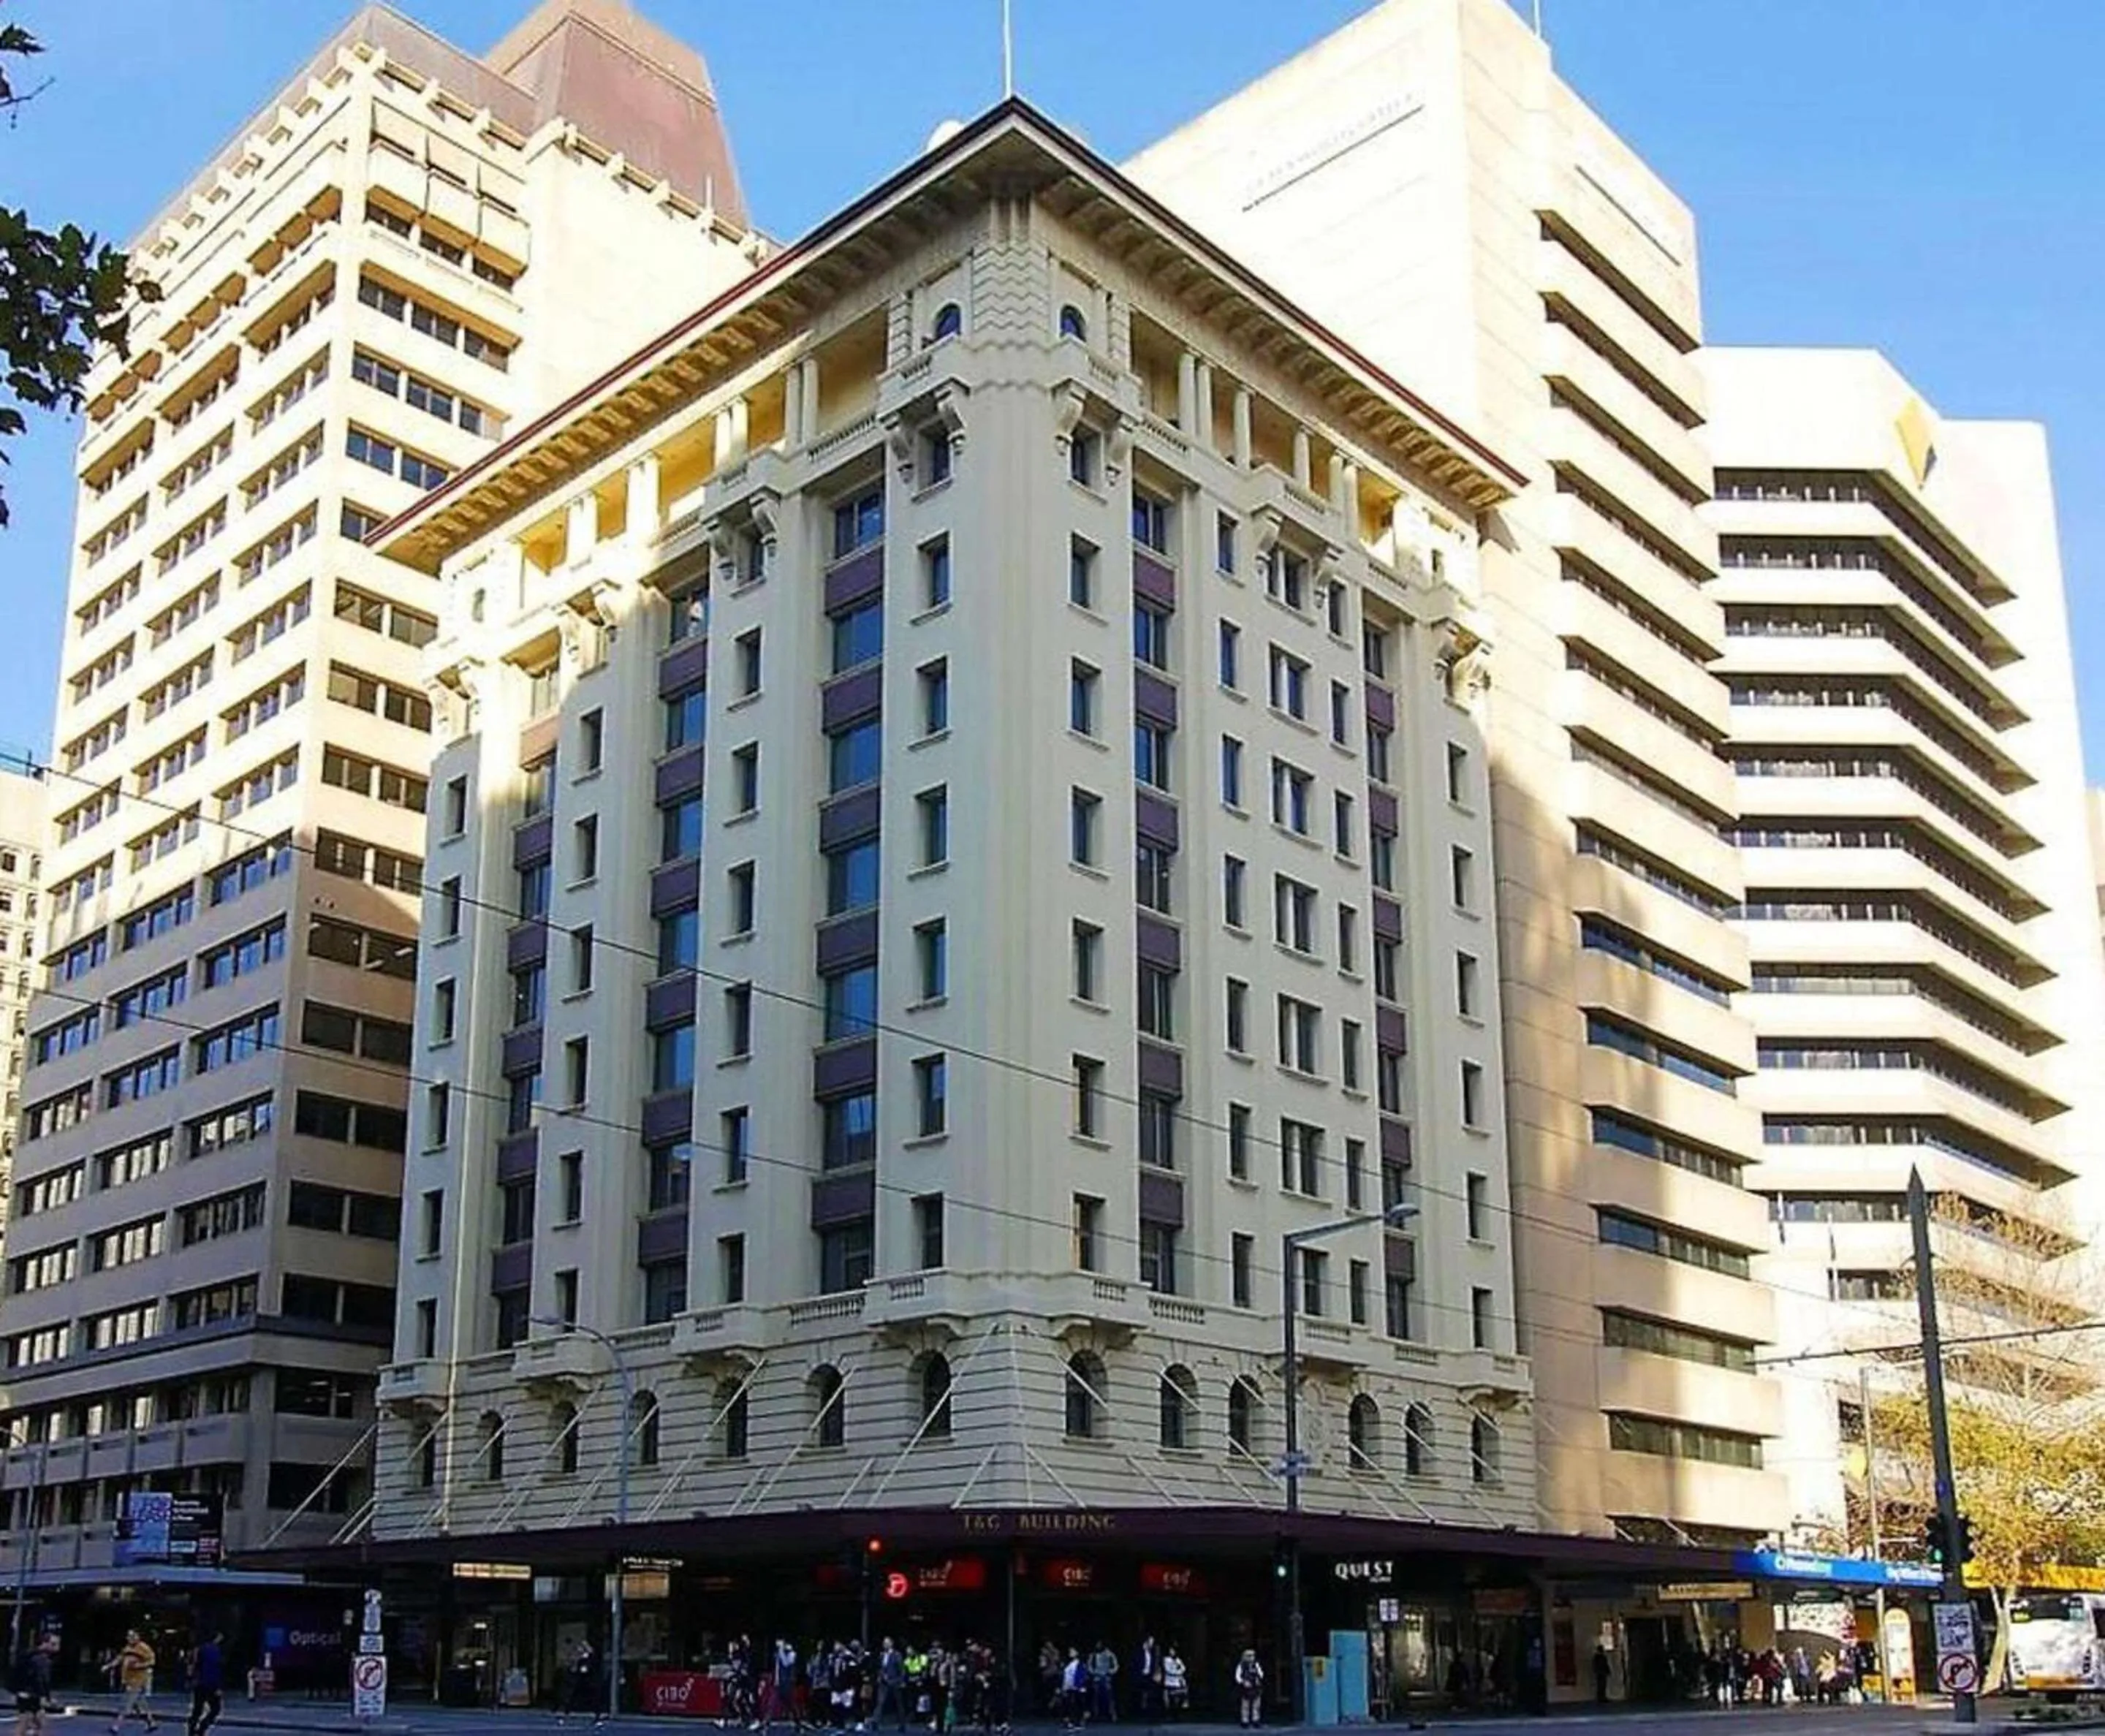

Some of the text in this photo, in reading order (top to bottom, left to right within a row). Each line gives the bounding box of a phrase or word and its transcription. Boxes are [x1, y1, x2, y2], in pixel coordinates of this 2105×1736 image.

[1019, 1513, 1116, 1530] BUILDING
[1334, 1560, 1394, 1581] QUEST
[288, 1629, 342, 1650] Optical
[655, 1683, 692, 1702] CIBO
